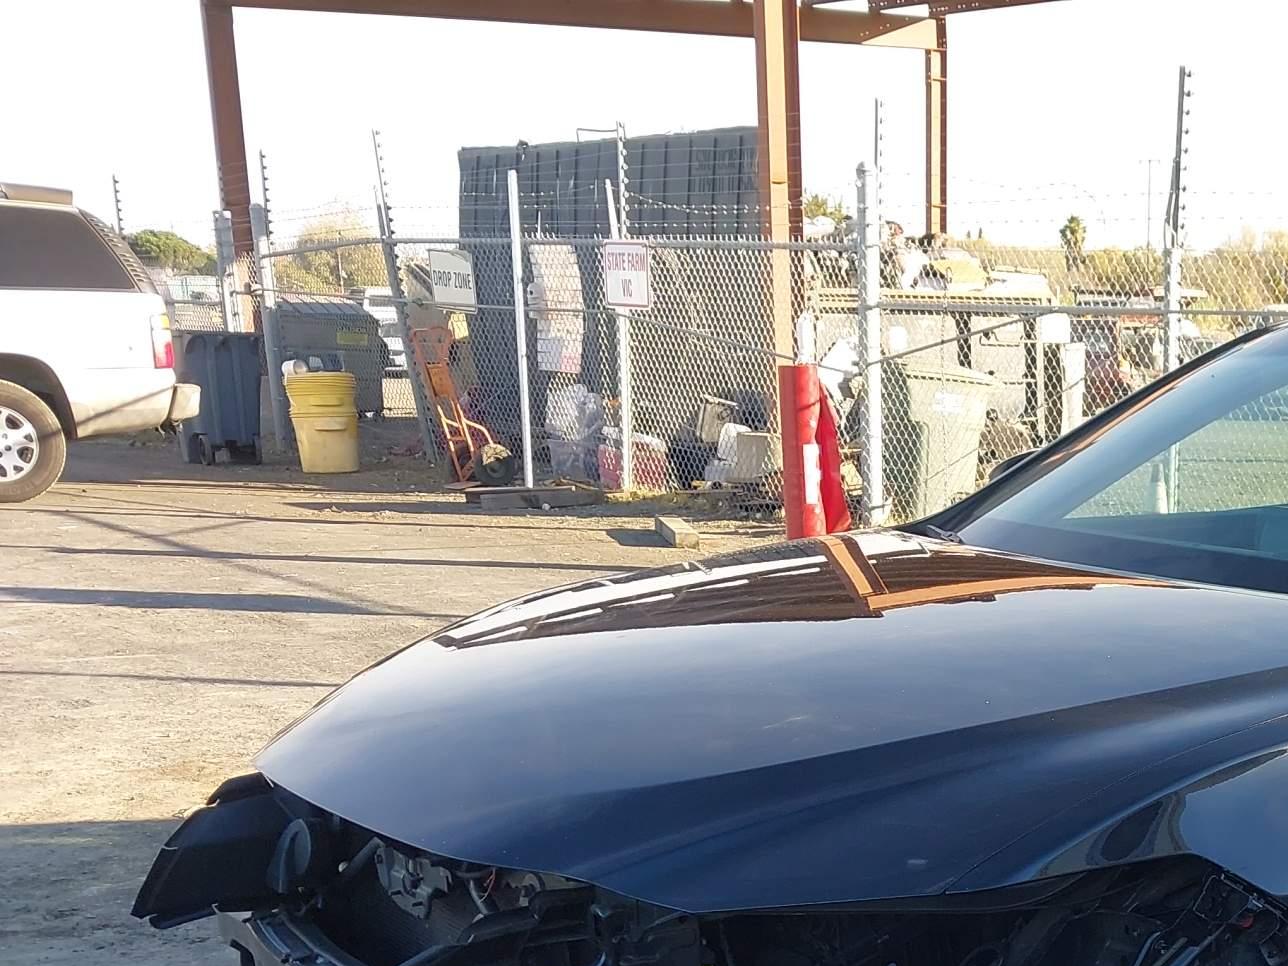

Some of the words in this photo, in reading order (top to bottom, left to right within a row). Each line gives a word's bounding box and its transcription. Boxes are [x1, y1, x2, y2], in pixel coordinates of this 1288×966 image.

[606, 252, 626, 271] STATE
[627, 252, 646, 272] FARM
[432, 269, 452, 288] DROP
[452, 271, 473, 290] ZONE
[621, 279, 633, 298] VIC
